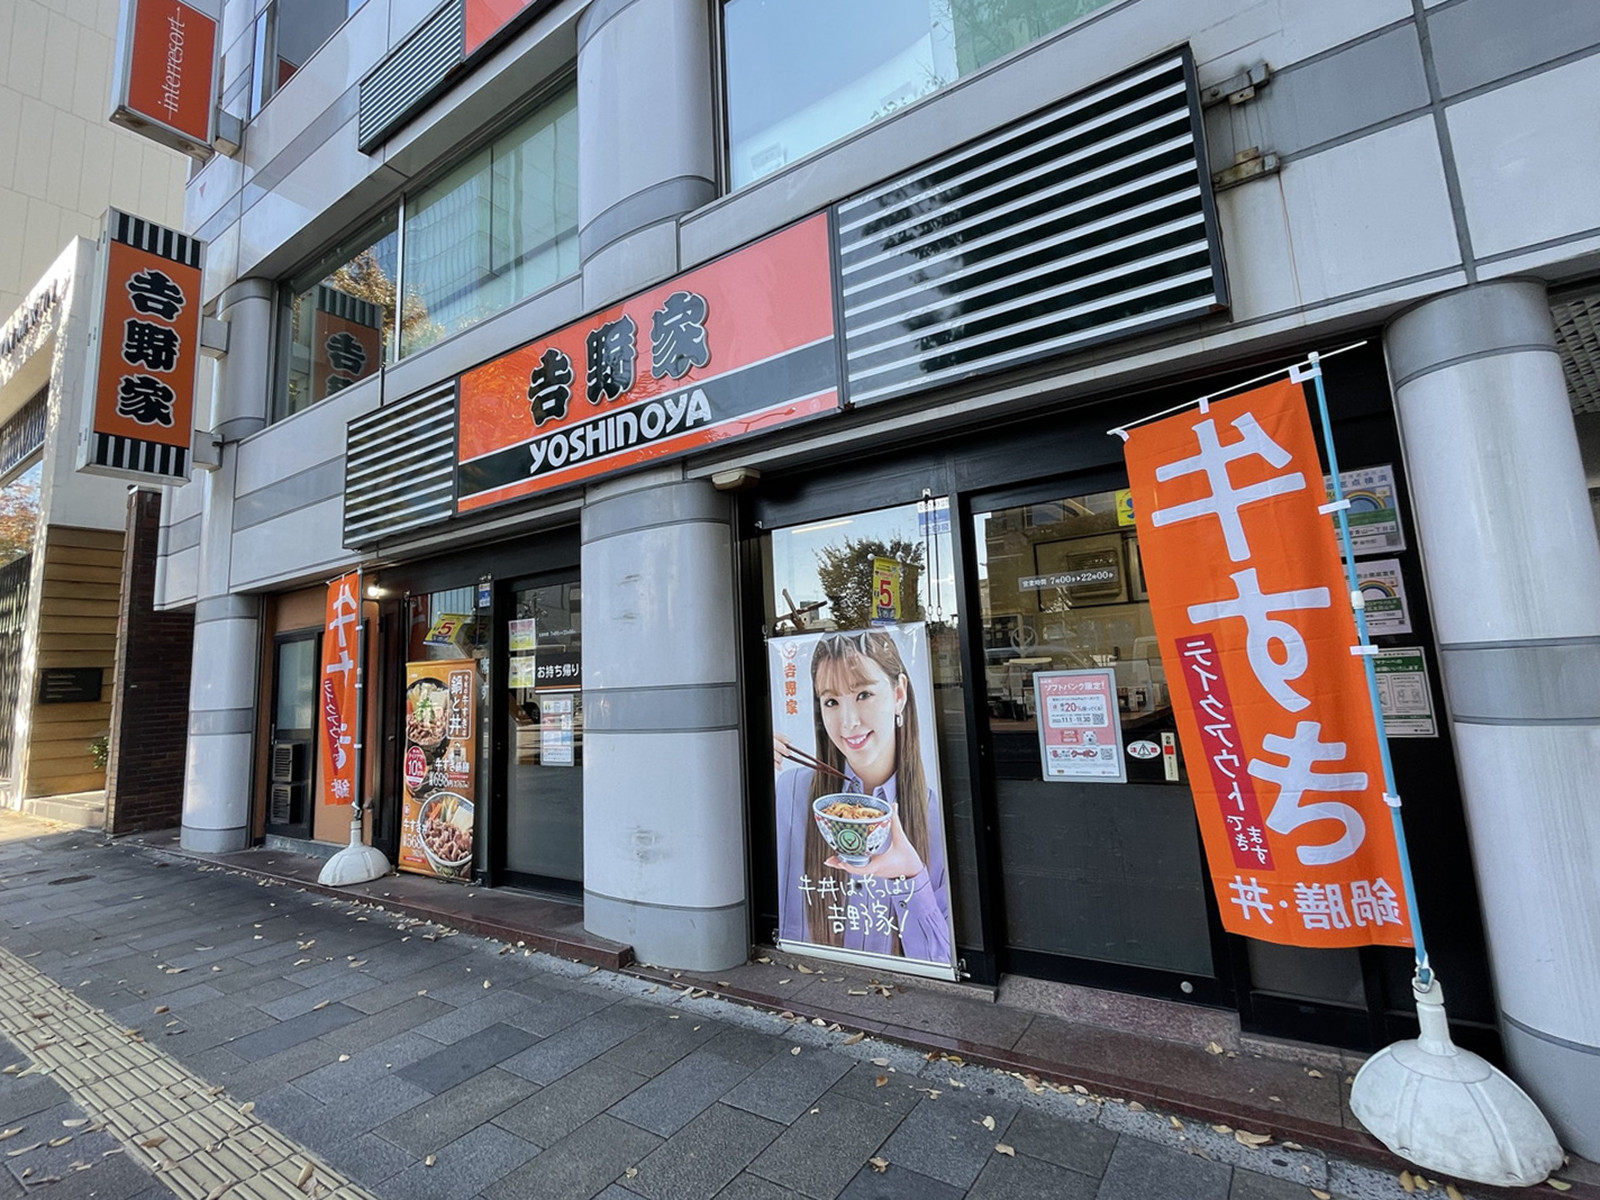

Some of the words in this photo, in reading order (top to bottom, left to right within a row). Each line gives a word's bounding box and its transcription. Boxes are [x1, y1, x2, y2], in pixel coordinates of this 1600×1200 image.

[157, 8, 187, 118] interresort
[117, 269, 187, 428] 吉野家
[527, 290, 712, 427] 吉野家
[528, 387, 713, 474] YOSHINOYA
[437, 620, 456, 636] 5
[879, 579, 892, 608] 5
[784, 662, 799, 715] 吉野家
